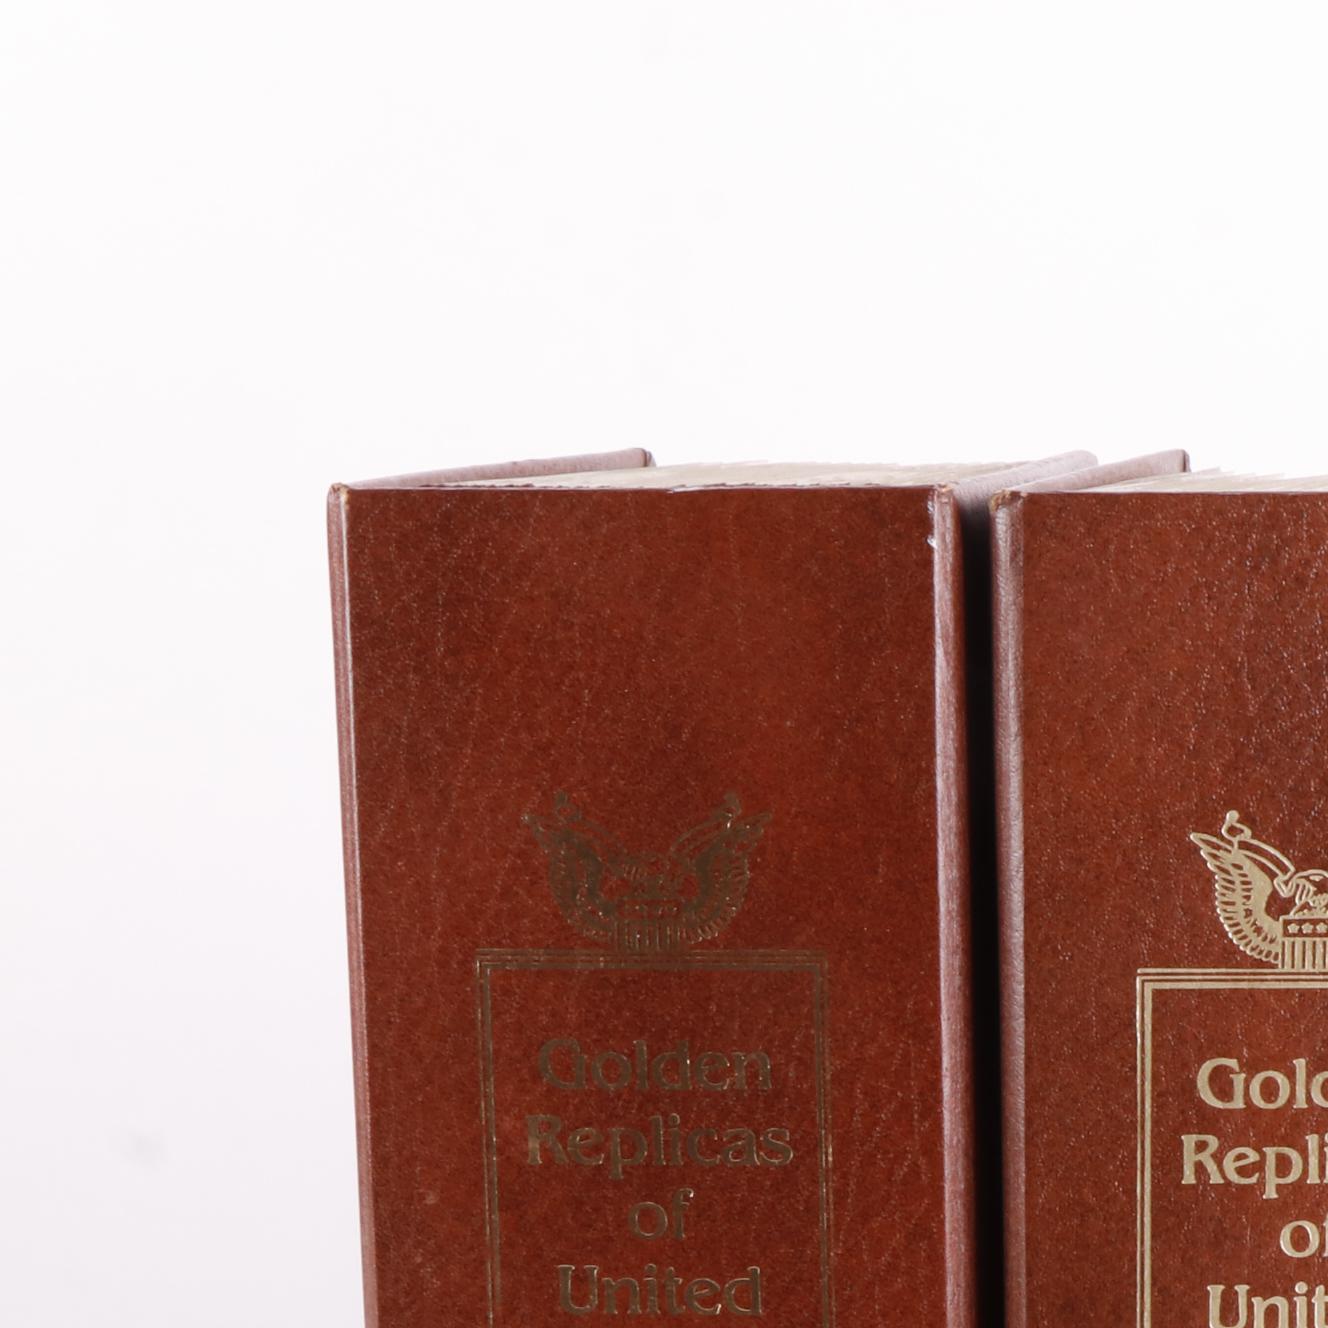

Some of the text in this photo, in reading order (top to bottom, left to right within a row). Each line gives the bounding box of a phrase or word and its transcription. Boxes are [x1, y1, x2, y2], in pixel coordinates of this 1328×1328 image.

[538, 1039, 772, 1091] Golden
[526, 1113, 794, 1180] Replicas
[629, 1188, 694, 1240] of
[557, 1264, 762, 1316] United
